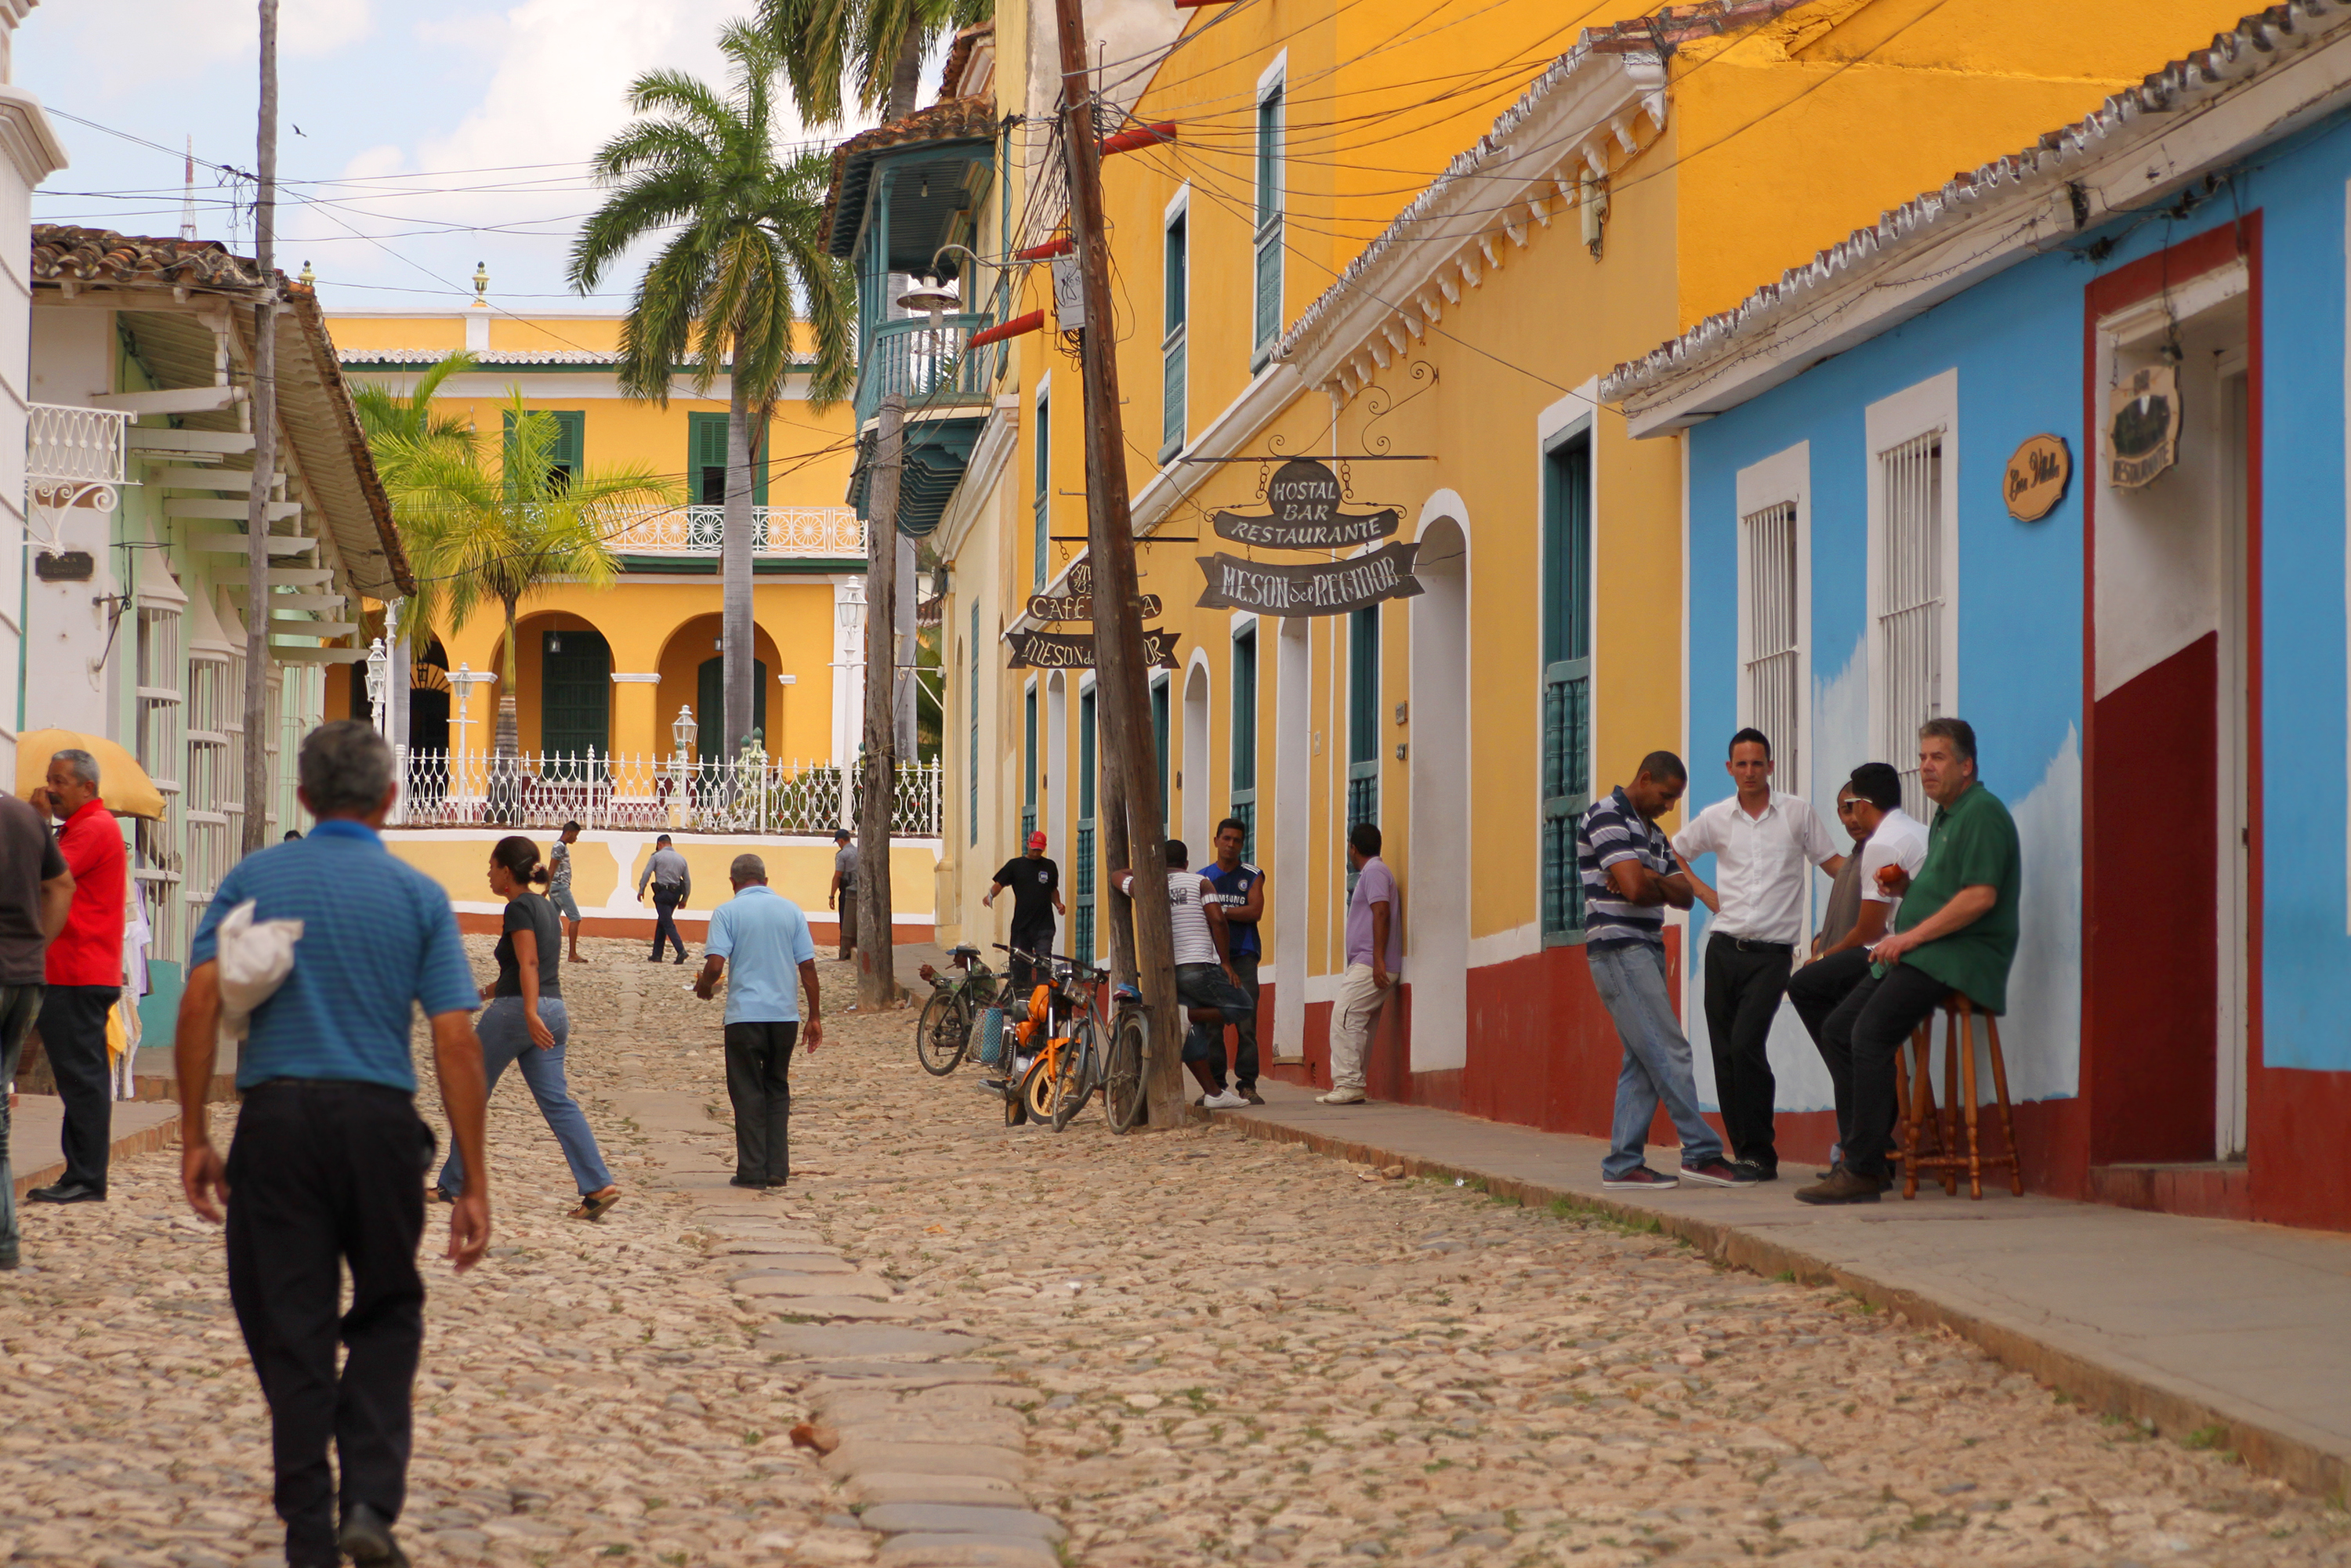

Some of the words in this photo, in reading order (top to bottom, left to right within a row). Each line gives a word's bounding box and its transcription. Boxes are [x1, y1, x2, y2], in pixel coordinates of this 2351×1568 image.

[1273, 481, 1336, 502] HOSTAL
[1283, 504, 1330, 521] BAR
[1231, 517, 1382, 545] RESTAURANTE
[1221, 563, 1290, 609] MESON
[1313, 556, 1401, 607] REGIDOR
[1031, 596, 1160, 620] CAFEA
[1021, 636, 1084, 666] MESON
[1084, 650, 1096, 665] de
[1218, 893, 1246, 905] MSUNG
